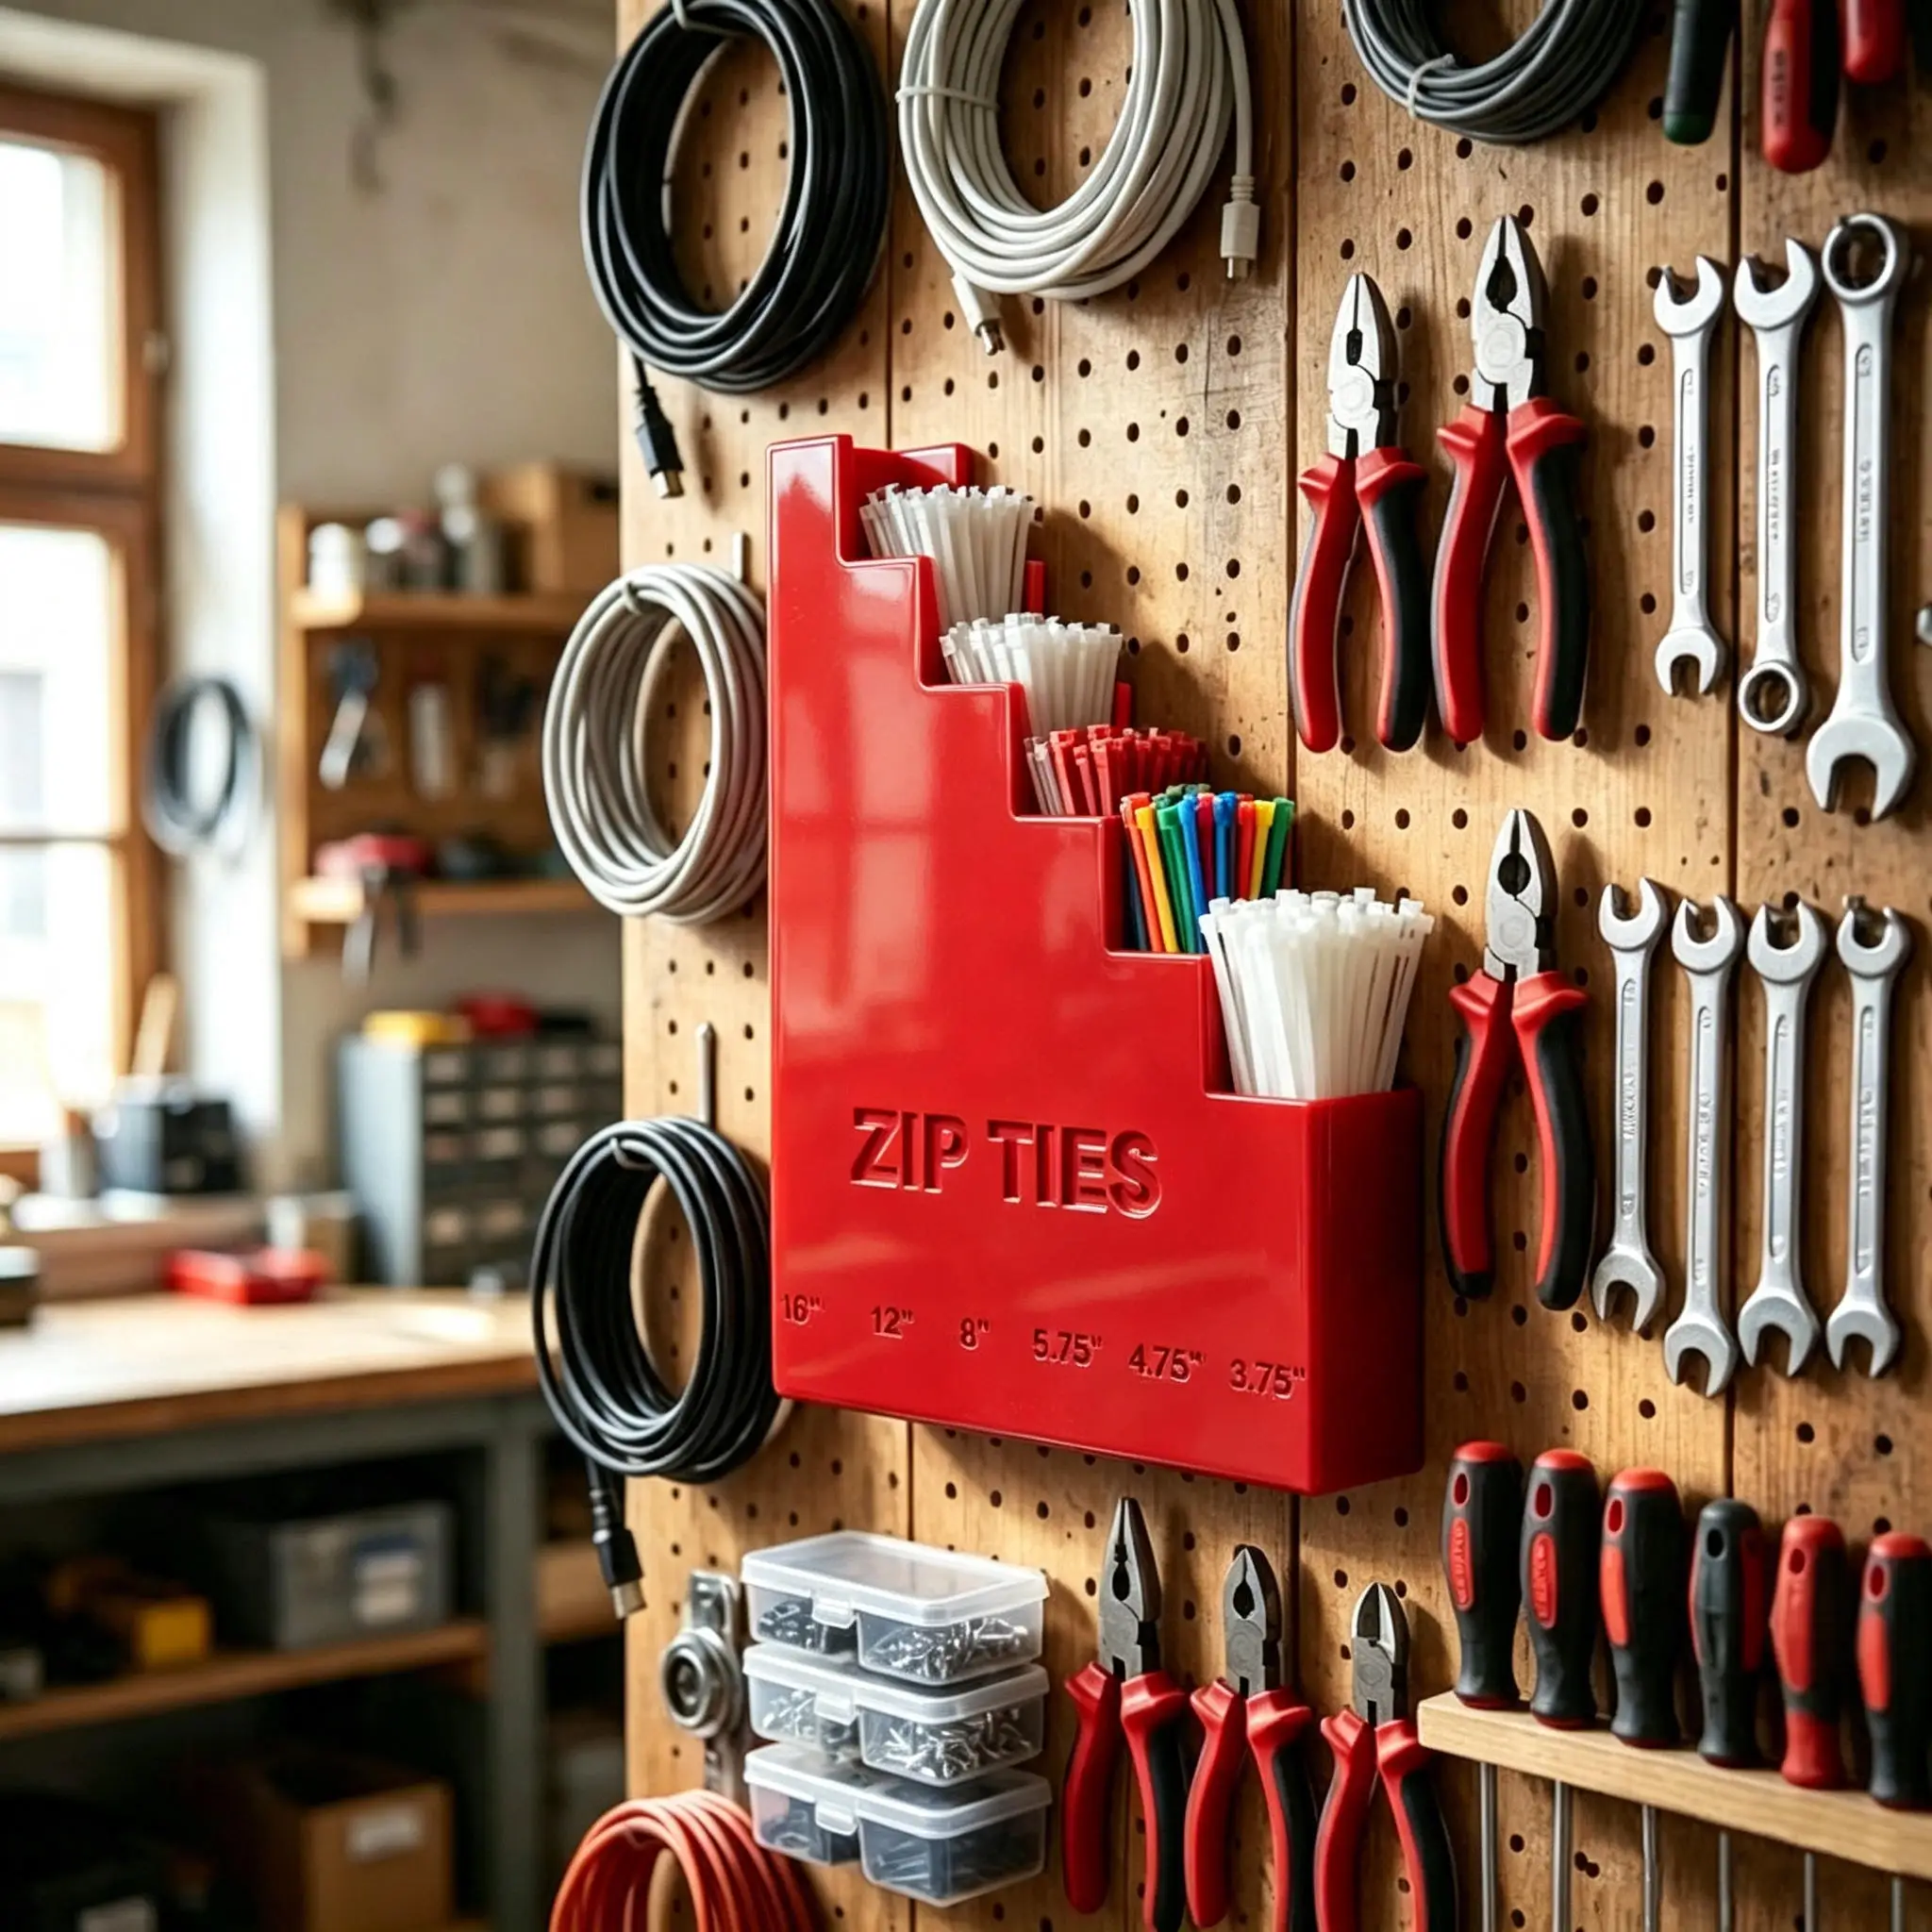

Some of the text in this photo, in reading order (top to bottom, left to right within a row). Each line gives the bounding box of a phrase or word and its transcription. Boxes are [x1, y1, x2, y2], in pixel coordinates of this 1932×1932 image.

[850, 1108, 1162, 1220] ZIP TIES
[781, 1293, 1307, 1399] 16" 12" 8" 5.75" 4.75" 3.75"
